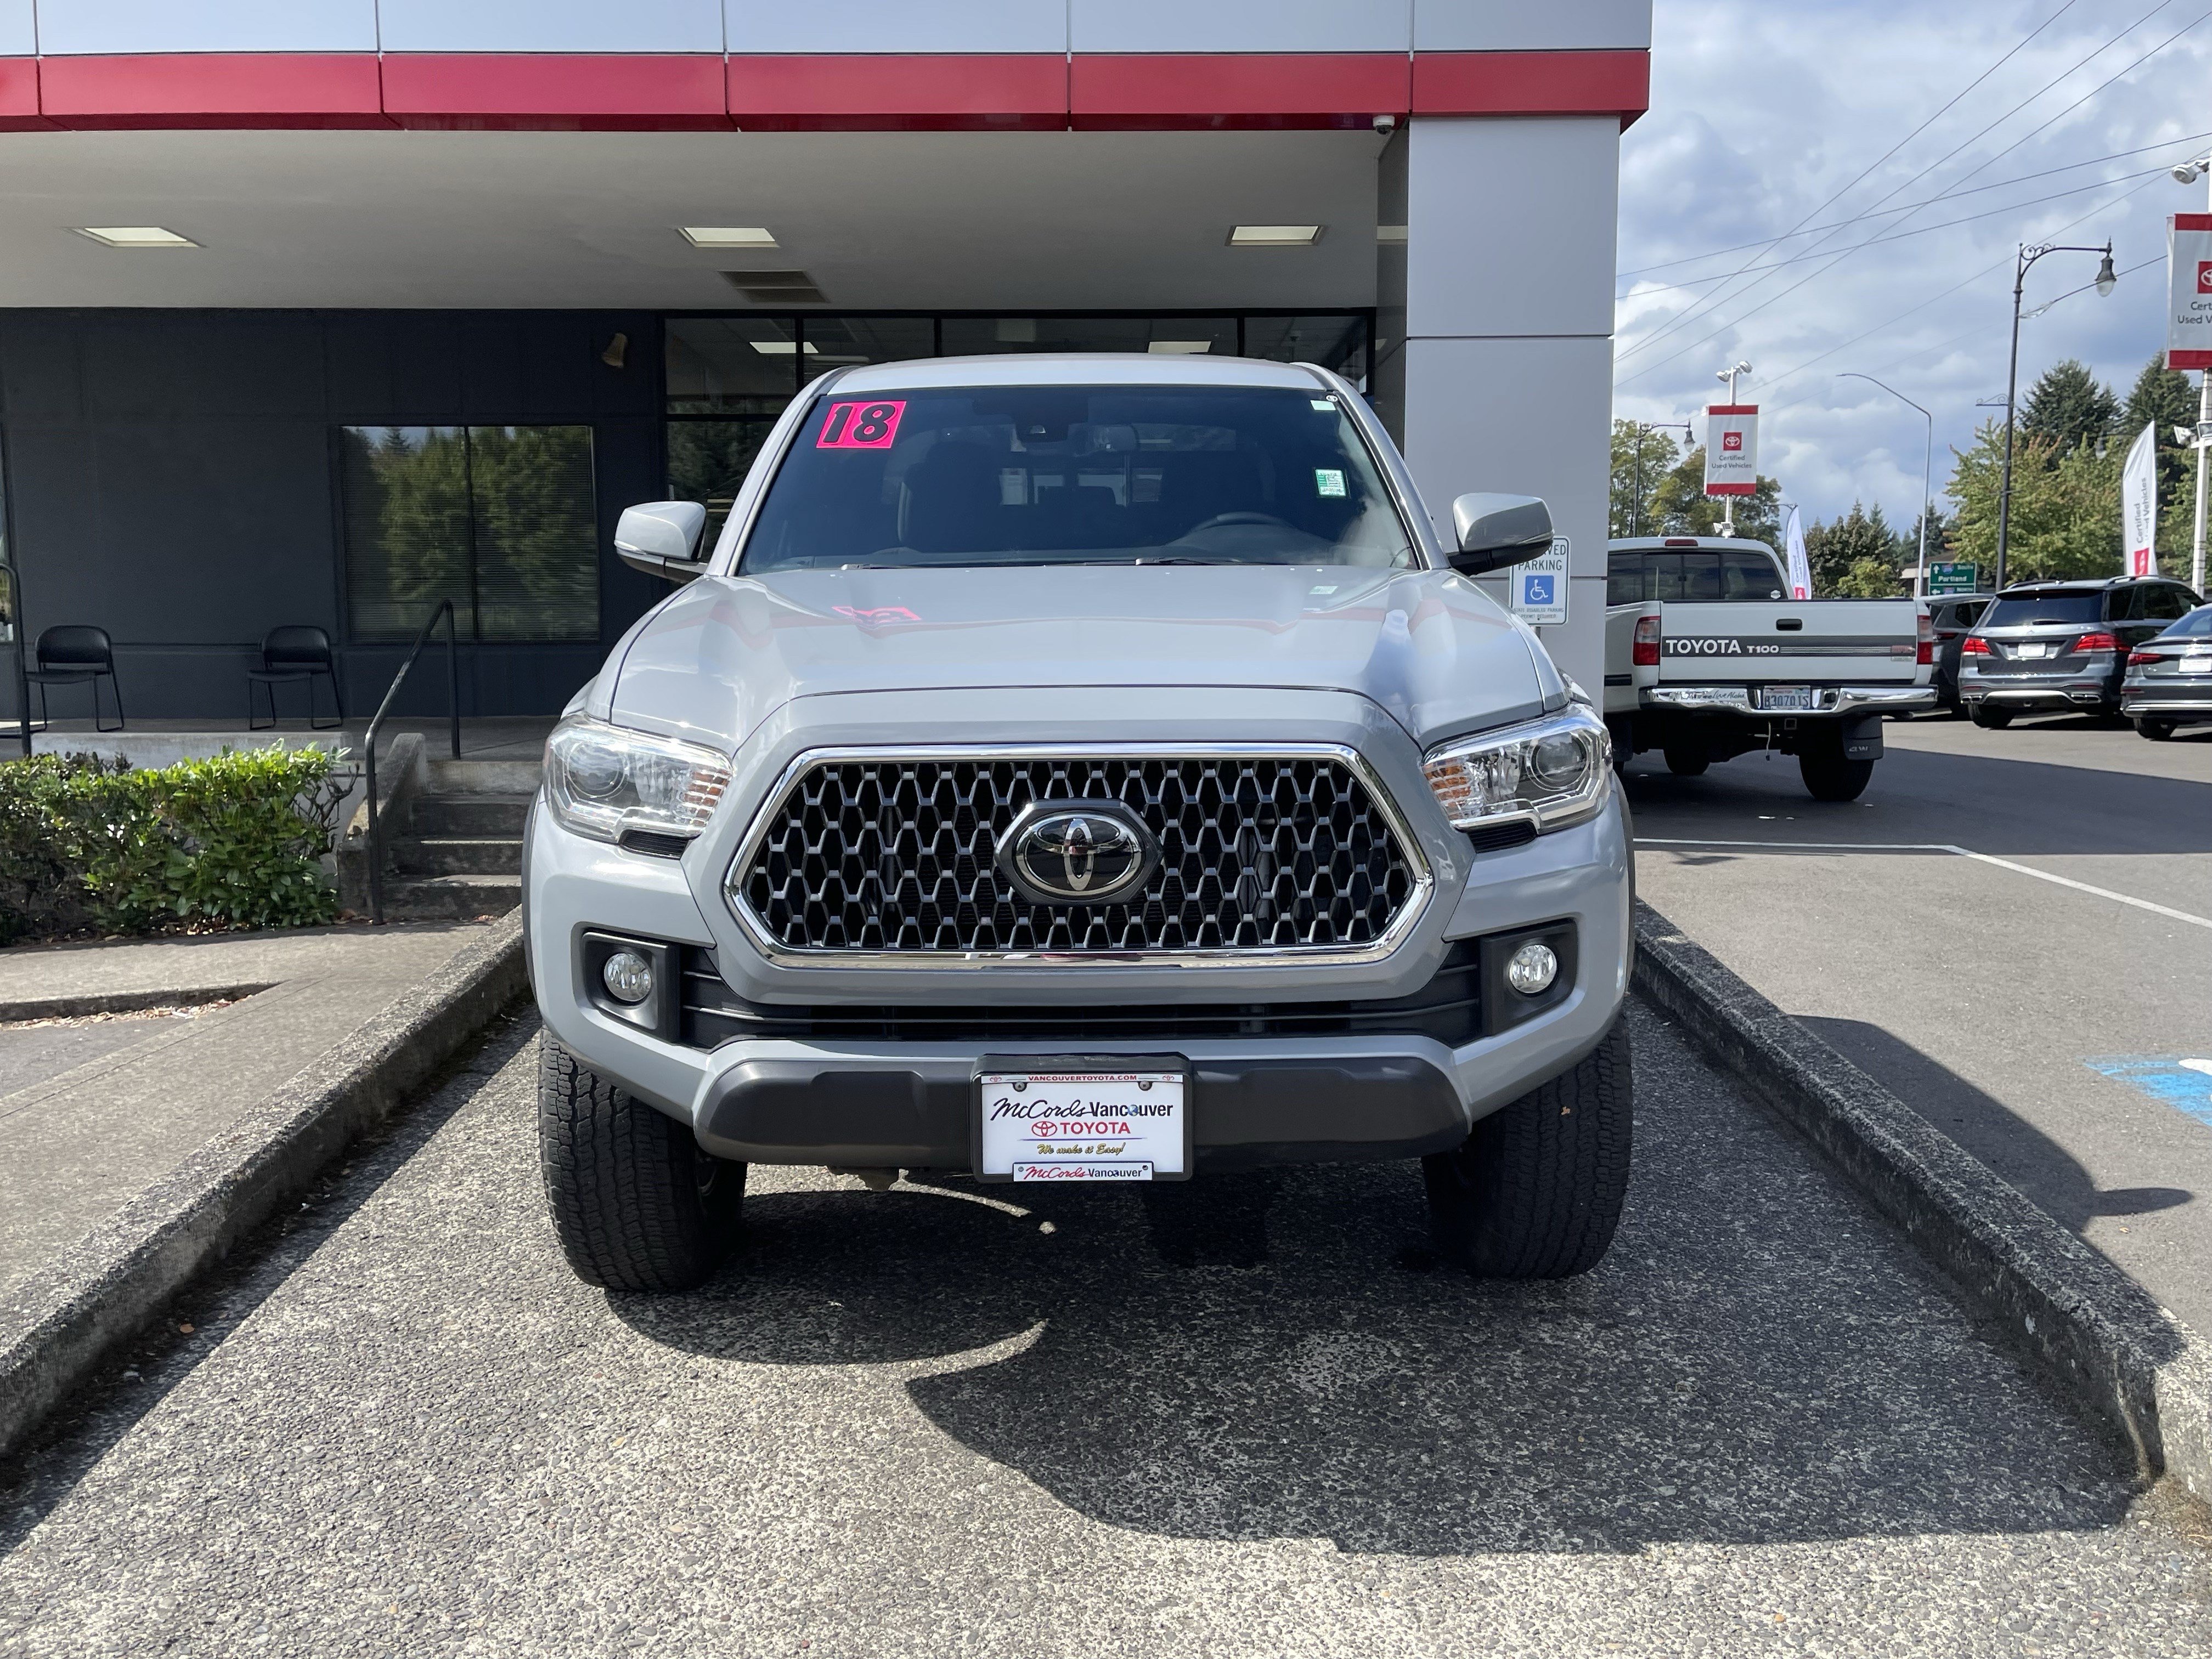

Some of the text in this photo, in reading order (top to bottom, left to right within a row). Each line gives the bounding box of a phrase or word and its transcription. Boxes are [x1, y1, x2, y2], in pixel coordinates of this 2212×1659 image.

[2177, 314, 2202, 324] Used
[823, 404, 896, 443] 18
[2141, 477, 2149, 517] Vehicles
[2134, 503, 2143, 544] Certified
[1518, 560, 1562, 571] PARKING
[1665, 639, 1780, 654] TOYOTA T100
[1059, 1121, 1131, 1135] TOYOTA
[1037, 1142, 1126, 1155] We make it Easy!
